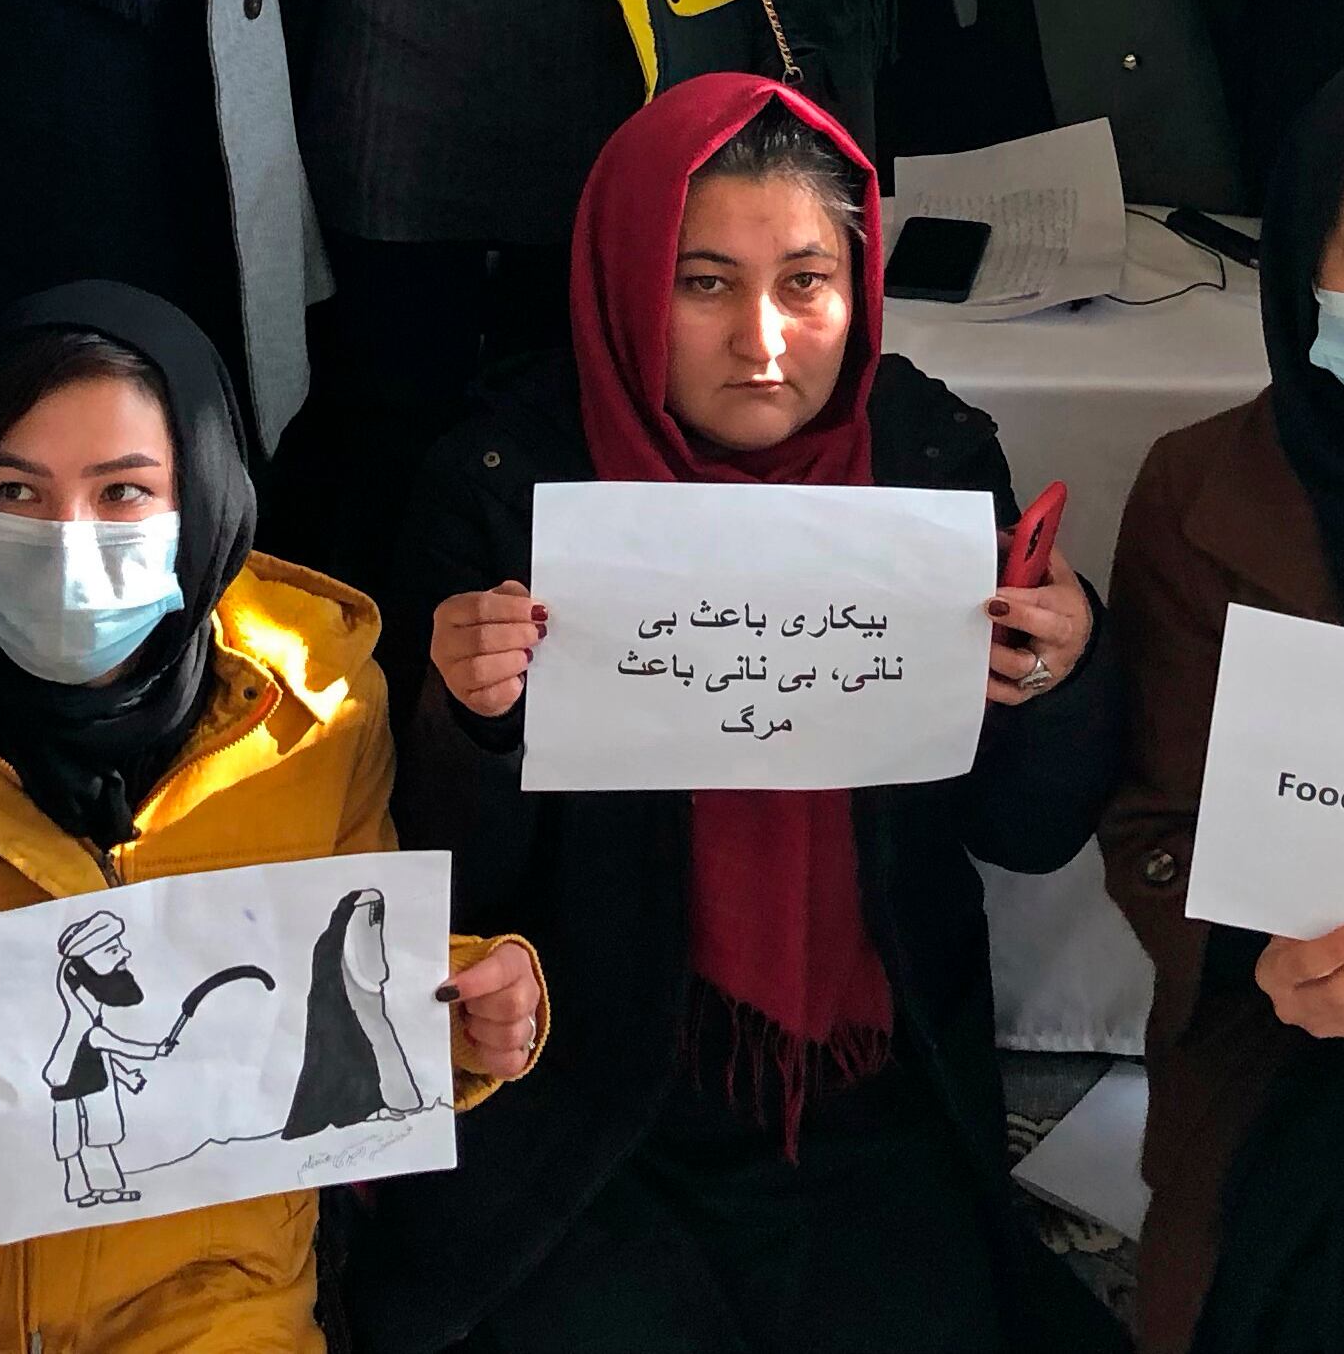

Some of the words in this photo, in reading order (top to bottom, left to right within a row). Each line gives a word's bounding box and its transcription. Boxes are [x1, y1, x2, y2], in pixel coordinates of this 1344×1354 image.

[638, 611, 677, 640] بی
[689, 599, 767, 638] باعث
[780, 603, 888, 639] بیکاری
[617, 650, 695, 687] باعث
[705, 655, 767, 693] نانی
[777, 666, 817, 693] بی
[831, 656, 904, 693] نانی،
[720, 704, 793, 741] مرگ
